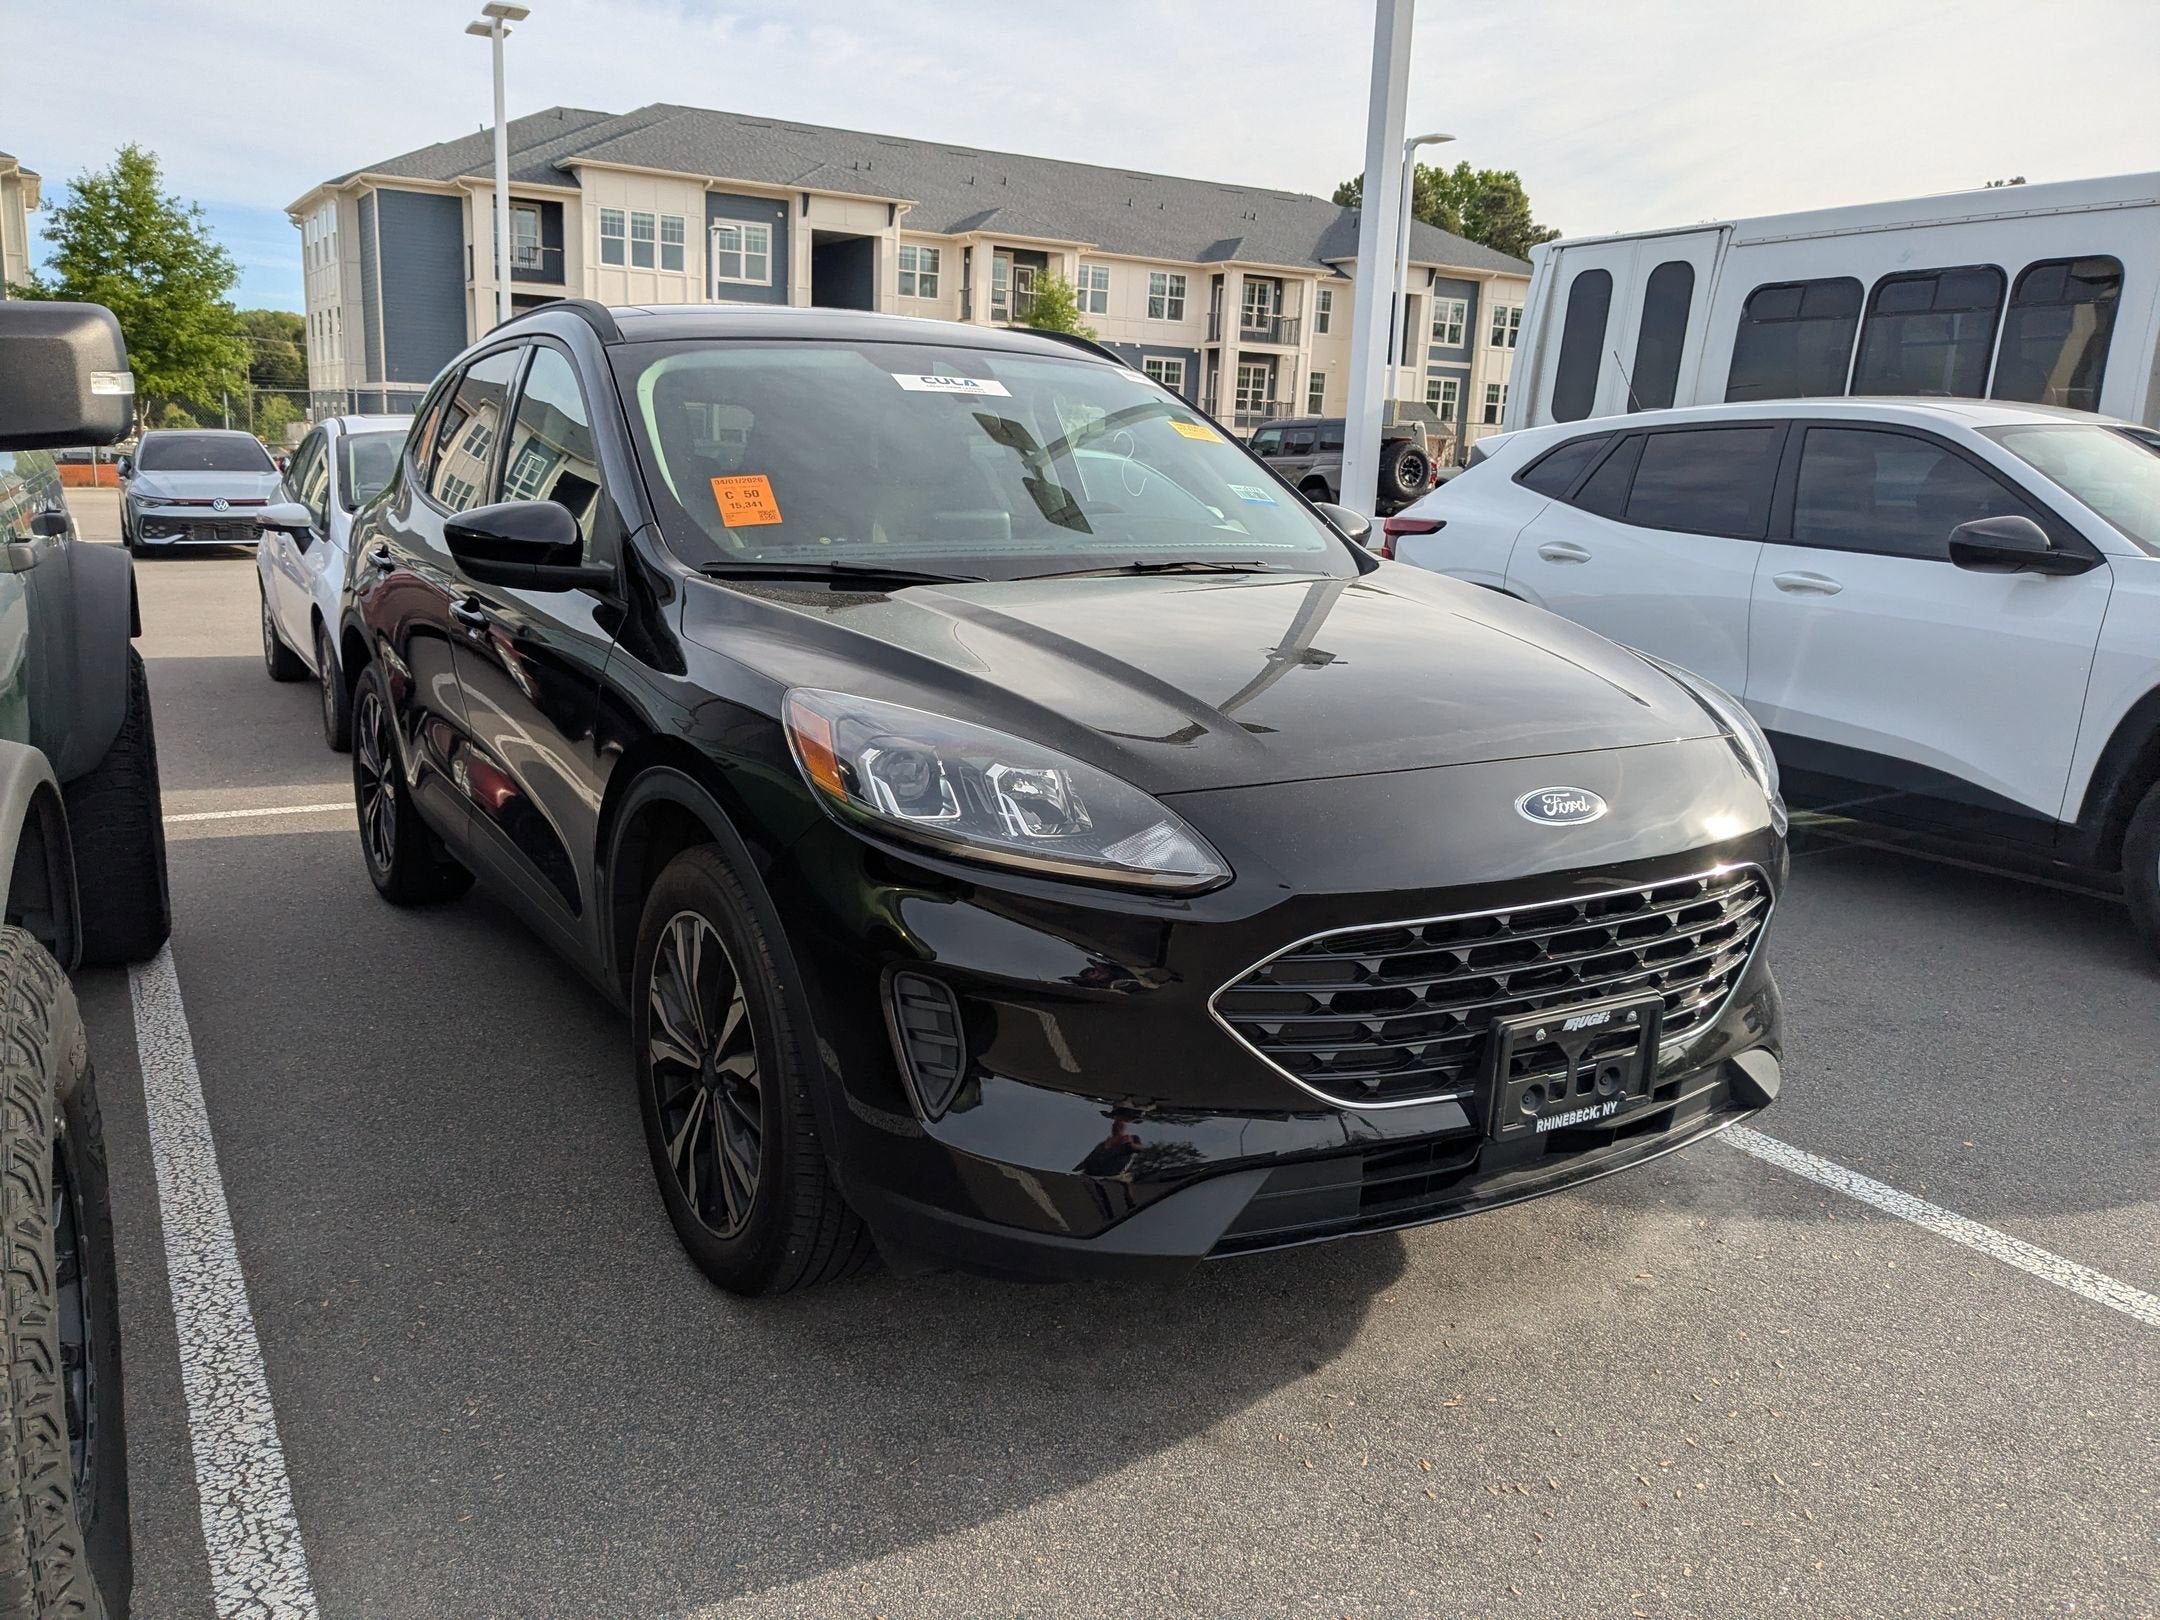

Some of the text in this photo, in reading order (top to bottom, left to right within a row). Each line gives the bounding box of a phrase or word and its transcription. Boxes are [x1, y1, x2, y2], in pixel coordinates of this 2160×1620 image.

[920, 376, 980, 387] CULA
[724, 489, 760, 499] C 50
[729, 501, 763, 509] 15,341
[1541, 792, 1591, 816] Ford
[1536, 1101, 1618, 1133] RHINEBECK, NY
